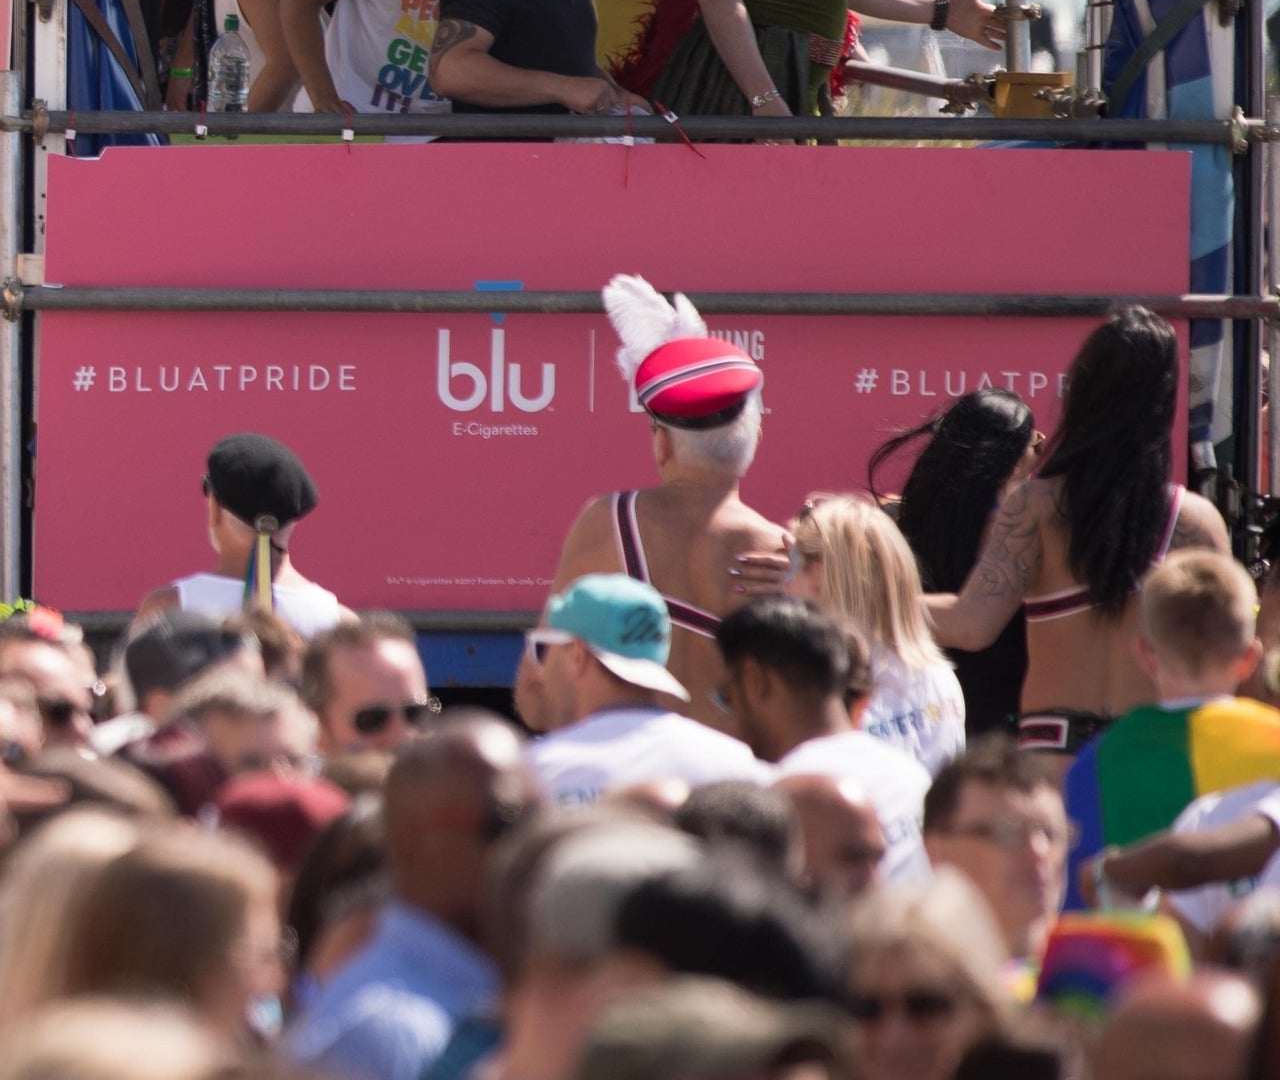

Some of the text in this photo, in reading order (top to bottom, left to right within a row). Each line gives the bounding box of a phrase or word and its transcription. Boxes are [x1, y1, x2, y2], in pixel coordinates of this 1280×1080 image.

[394, 13, 438, 48] AR
[387, 38, 428, 74] GE
[378, 64, 442, 101] OVE
[73, 365, 357, 392] #BLUATPRIDE
[436, 328, 555, 412] blu
[854, 368, 1072, 397] #BLUATP
[453, 422, 538, 439] E-Cigarettes
